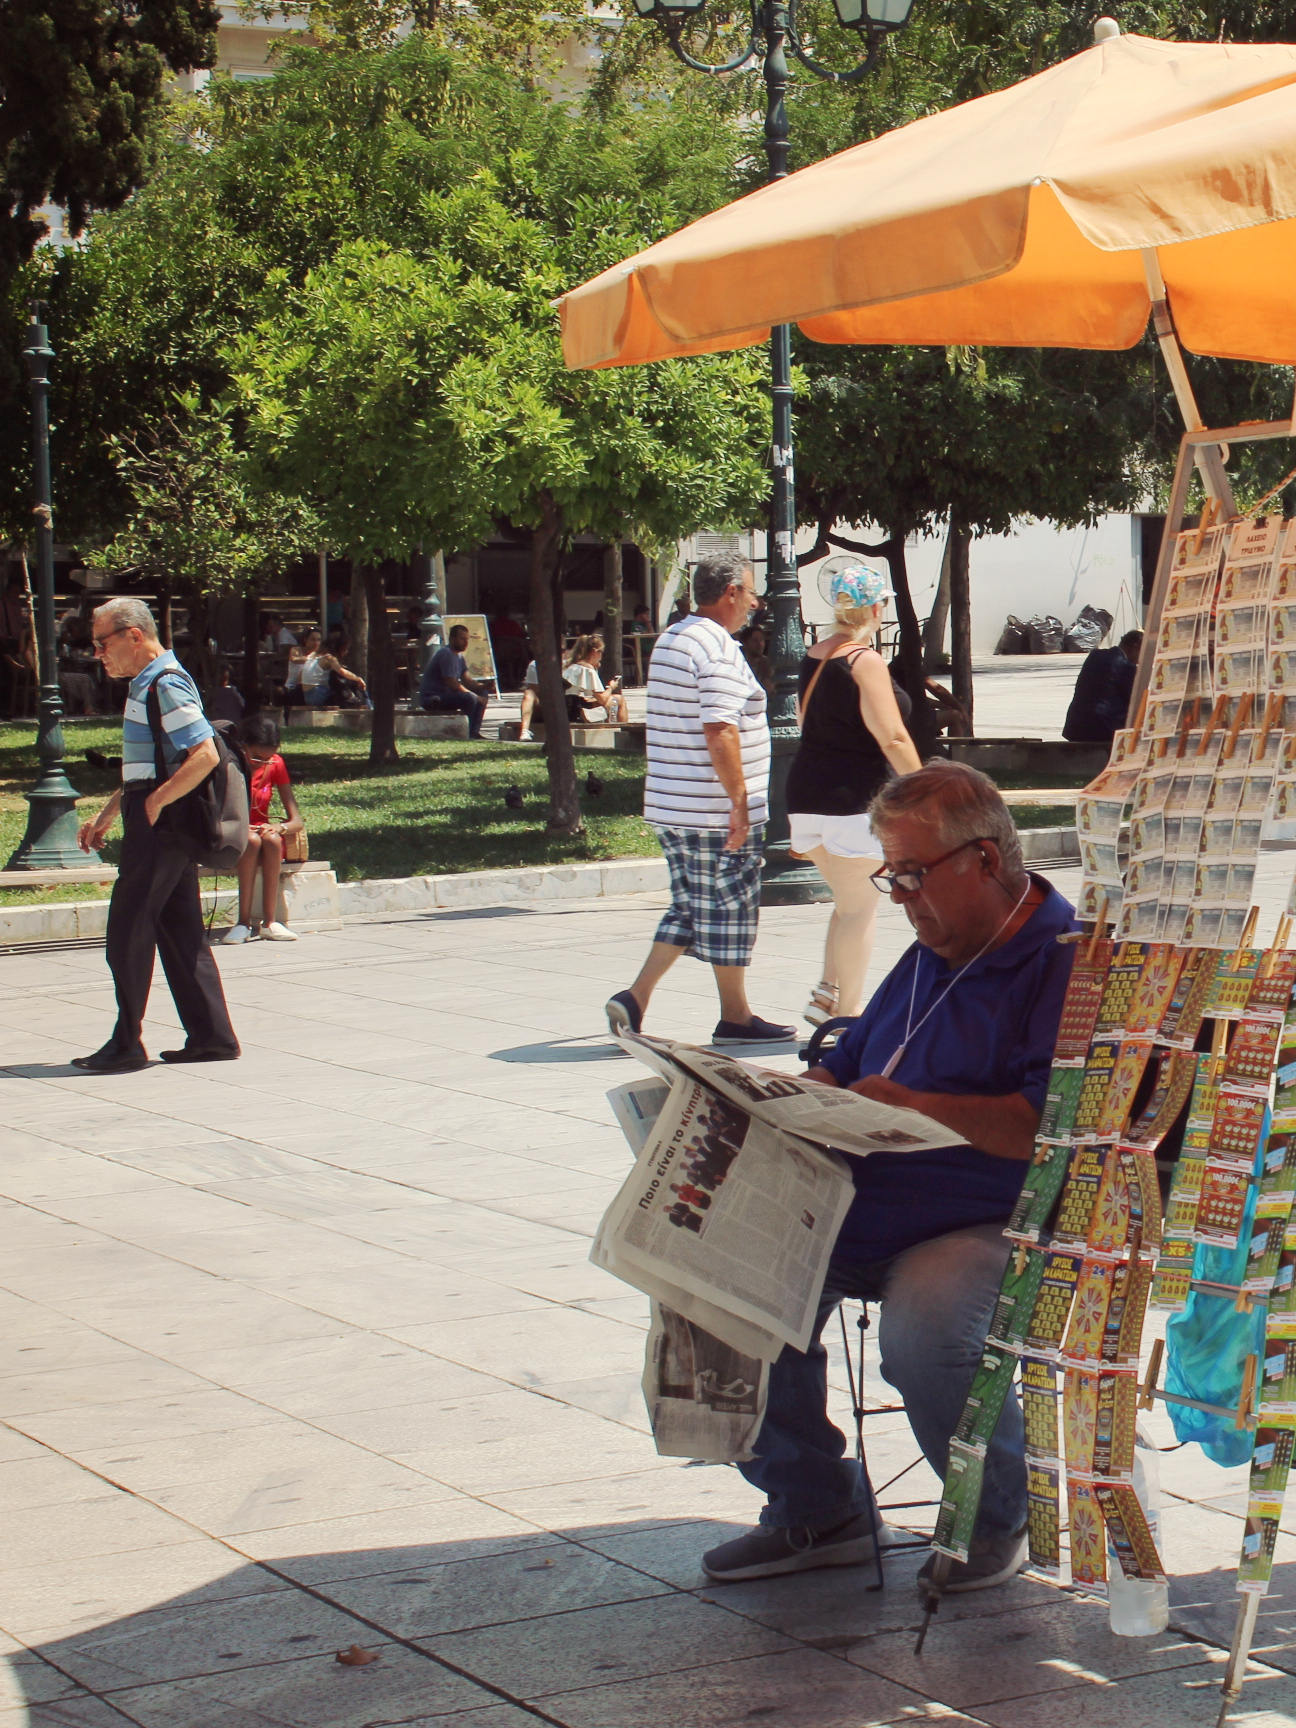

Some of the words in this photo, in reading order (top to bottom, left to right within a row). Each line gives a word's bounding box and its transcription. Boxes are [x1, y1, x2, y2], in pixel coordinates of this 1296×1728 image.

[638, 1178, 660, 1210] Ποιο
[672, 1129, 685, 1144] το
[1092, 1264, 1106, 1276] 24
[1076, 1485, 1090, 1497] 24
